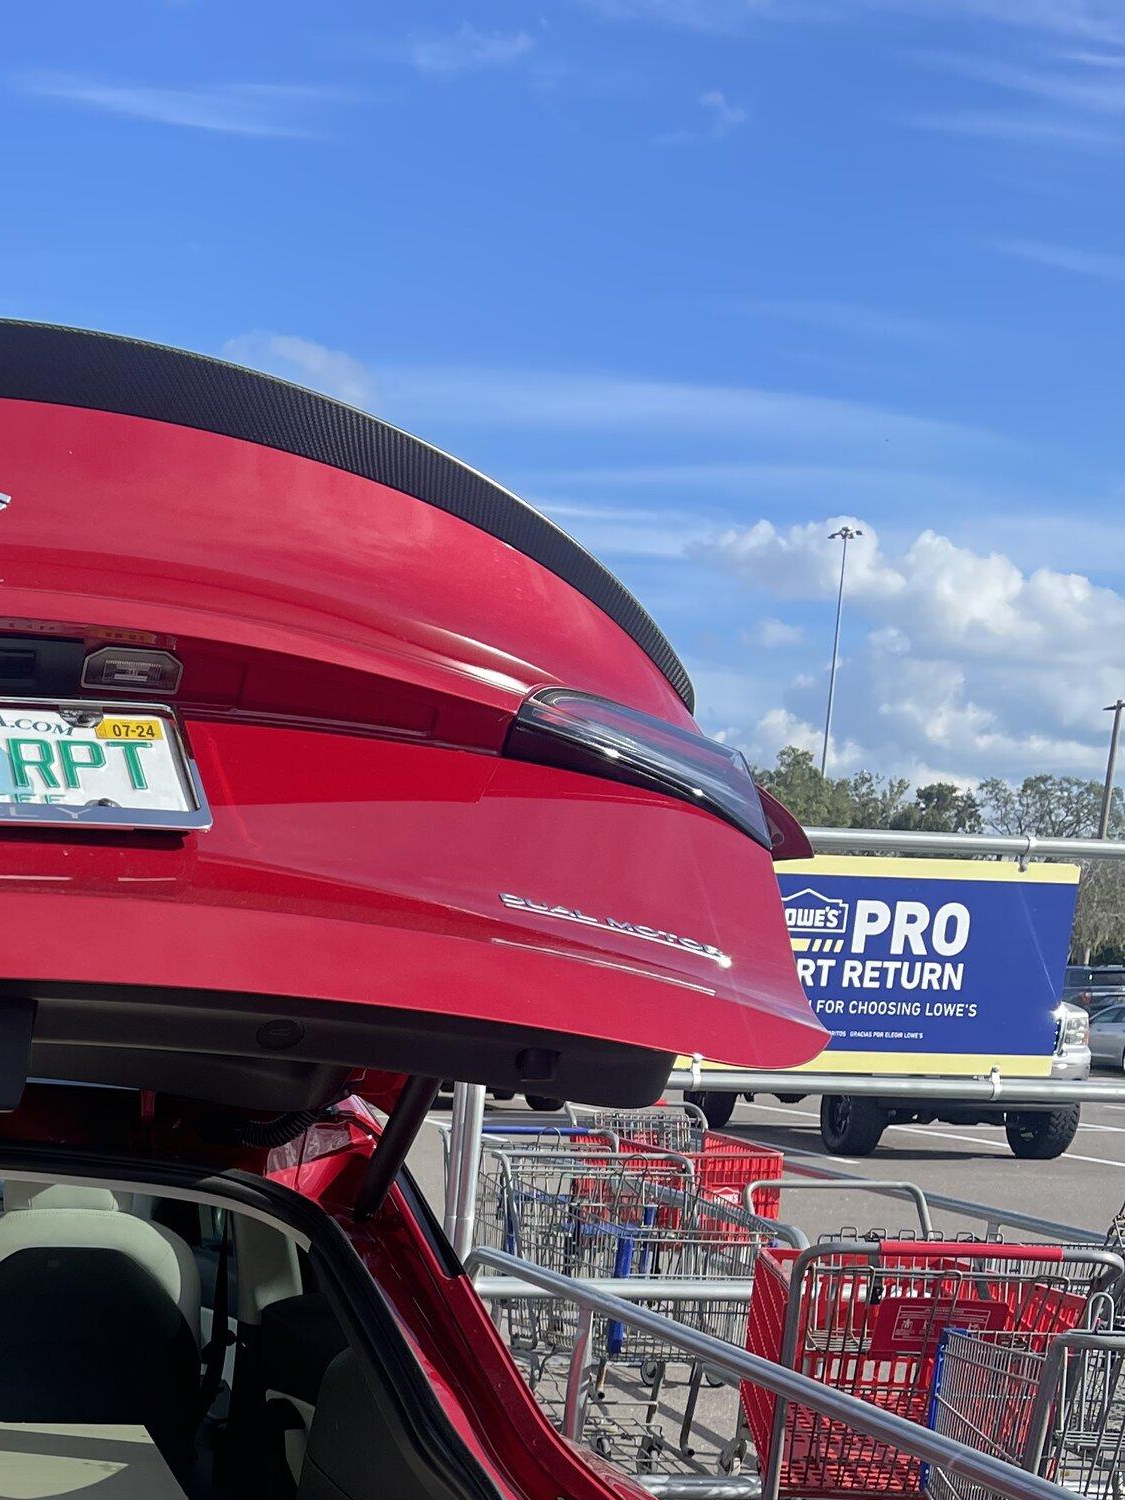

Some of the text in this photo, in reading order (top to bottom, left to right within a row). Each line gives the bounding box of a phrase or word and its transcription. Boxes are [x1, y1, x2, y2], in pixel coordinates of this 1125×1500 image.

[112, 724, 156, 738] 07-24
[6, 738, 154, 791] RPT
[56, 806, 92, 820] Y
[498, 892, 725, 958] DUAL MOTOR
[785, 899, 971, 957] OWE'S PRO
[796, 958, 965, 991] RT RETURN
[816, 999, 845, 1014] FOR
[848, 1000, 921, 1016] CHOOSING
[925, 1002, 978, 1018] LOWE'S
